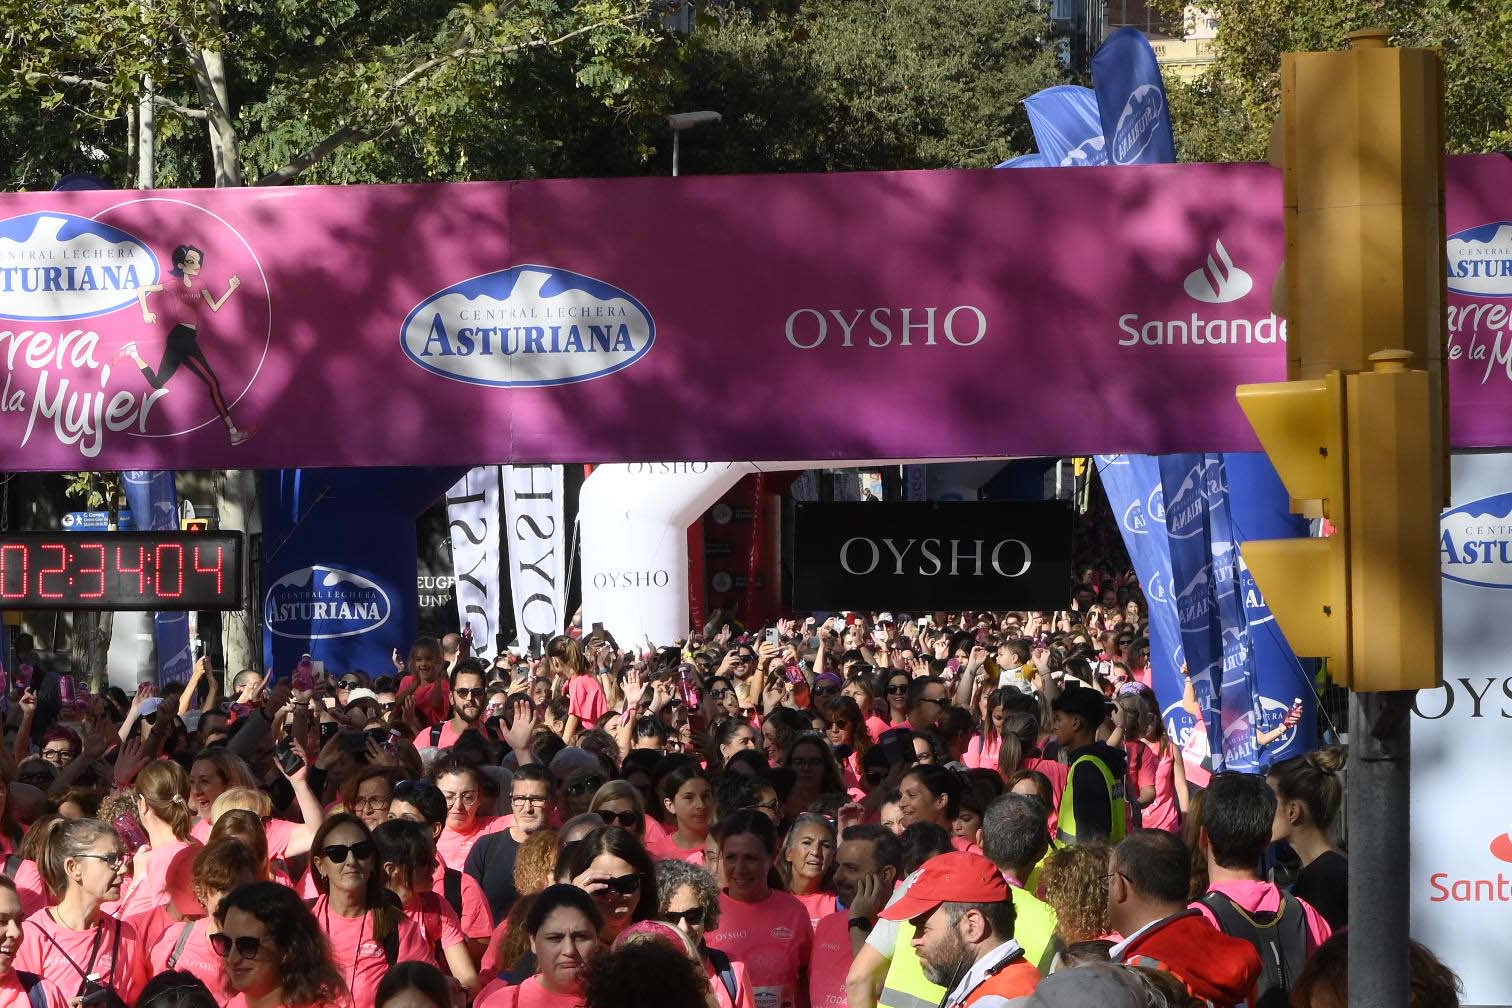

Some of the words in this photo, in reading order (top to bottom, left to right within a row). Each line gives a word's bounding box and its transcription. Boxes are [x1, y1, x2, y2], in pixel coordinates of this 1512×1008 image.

[63, 248, 135, 260] LECHERA
[459, 308, 538, 321] CENTRAL
[546, 306, 627, 319] LECHERA
[785, 305, 988, 349] OYSHO
[420, 312, 636, 357] ASTURIANA
[1118, 312, 1287, 347] Santand
[0, 370, 25, 412] la
[20, 364, 170, 458] Mujer
[0, 543, 224, 598] 02:34:04
[839, 537, 1033, 577] OYSHO
[328, 591, 377, 599] LECHERA
[593, 570, 669, 590] OYSHO
[269, 597, 382, 623] ASTURIANA
[1430, 872, 1512, 902] Sant
[826, 994, 847, 1005] TODA
